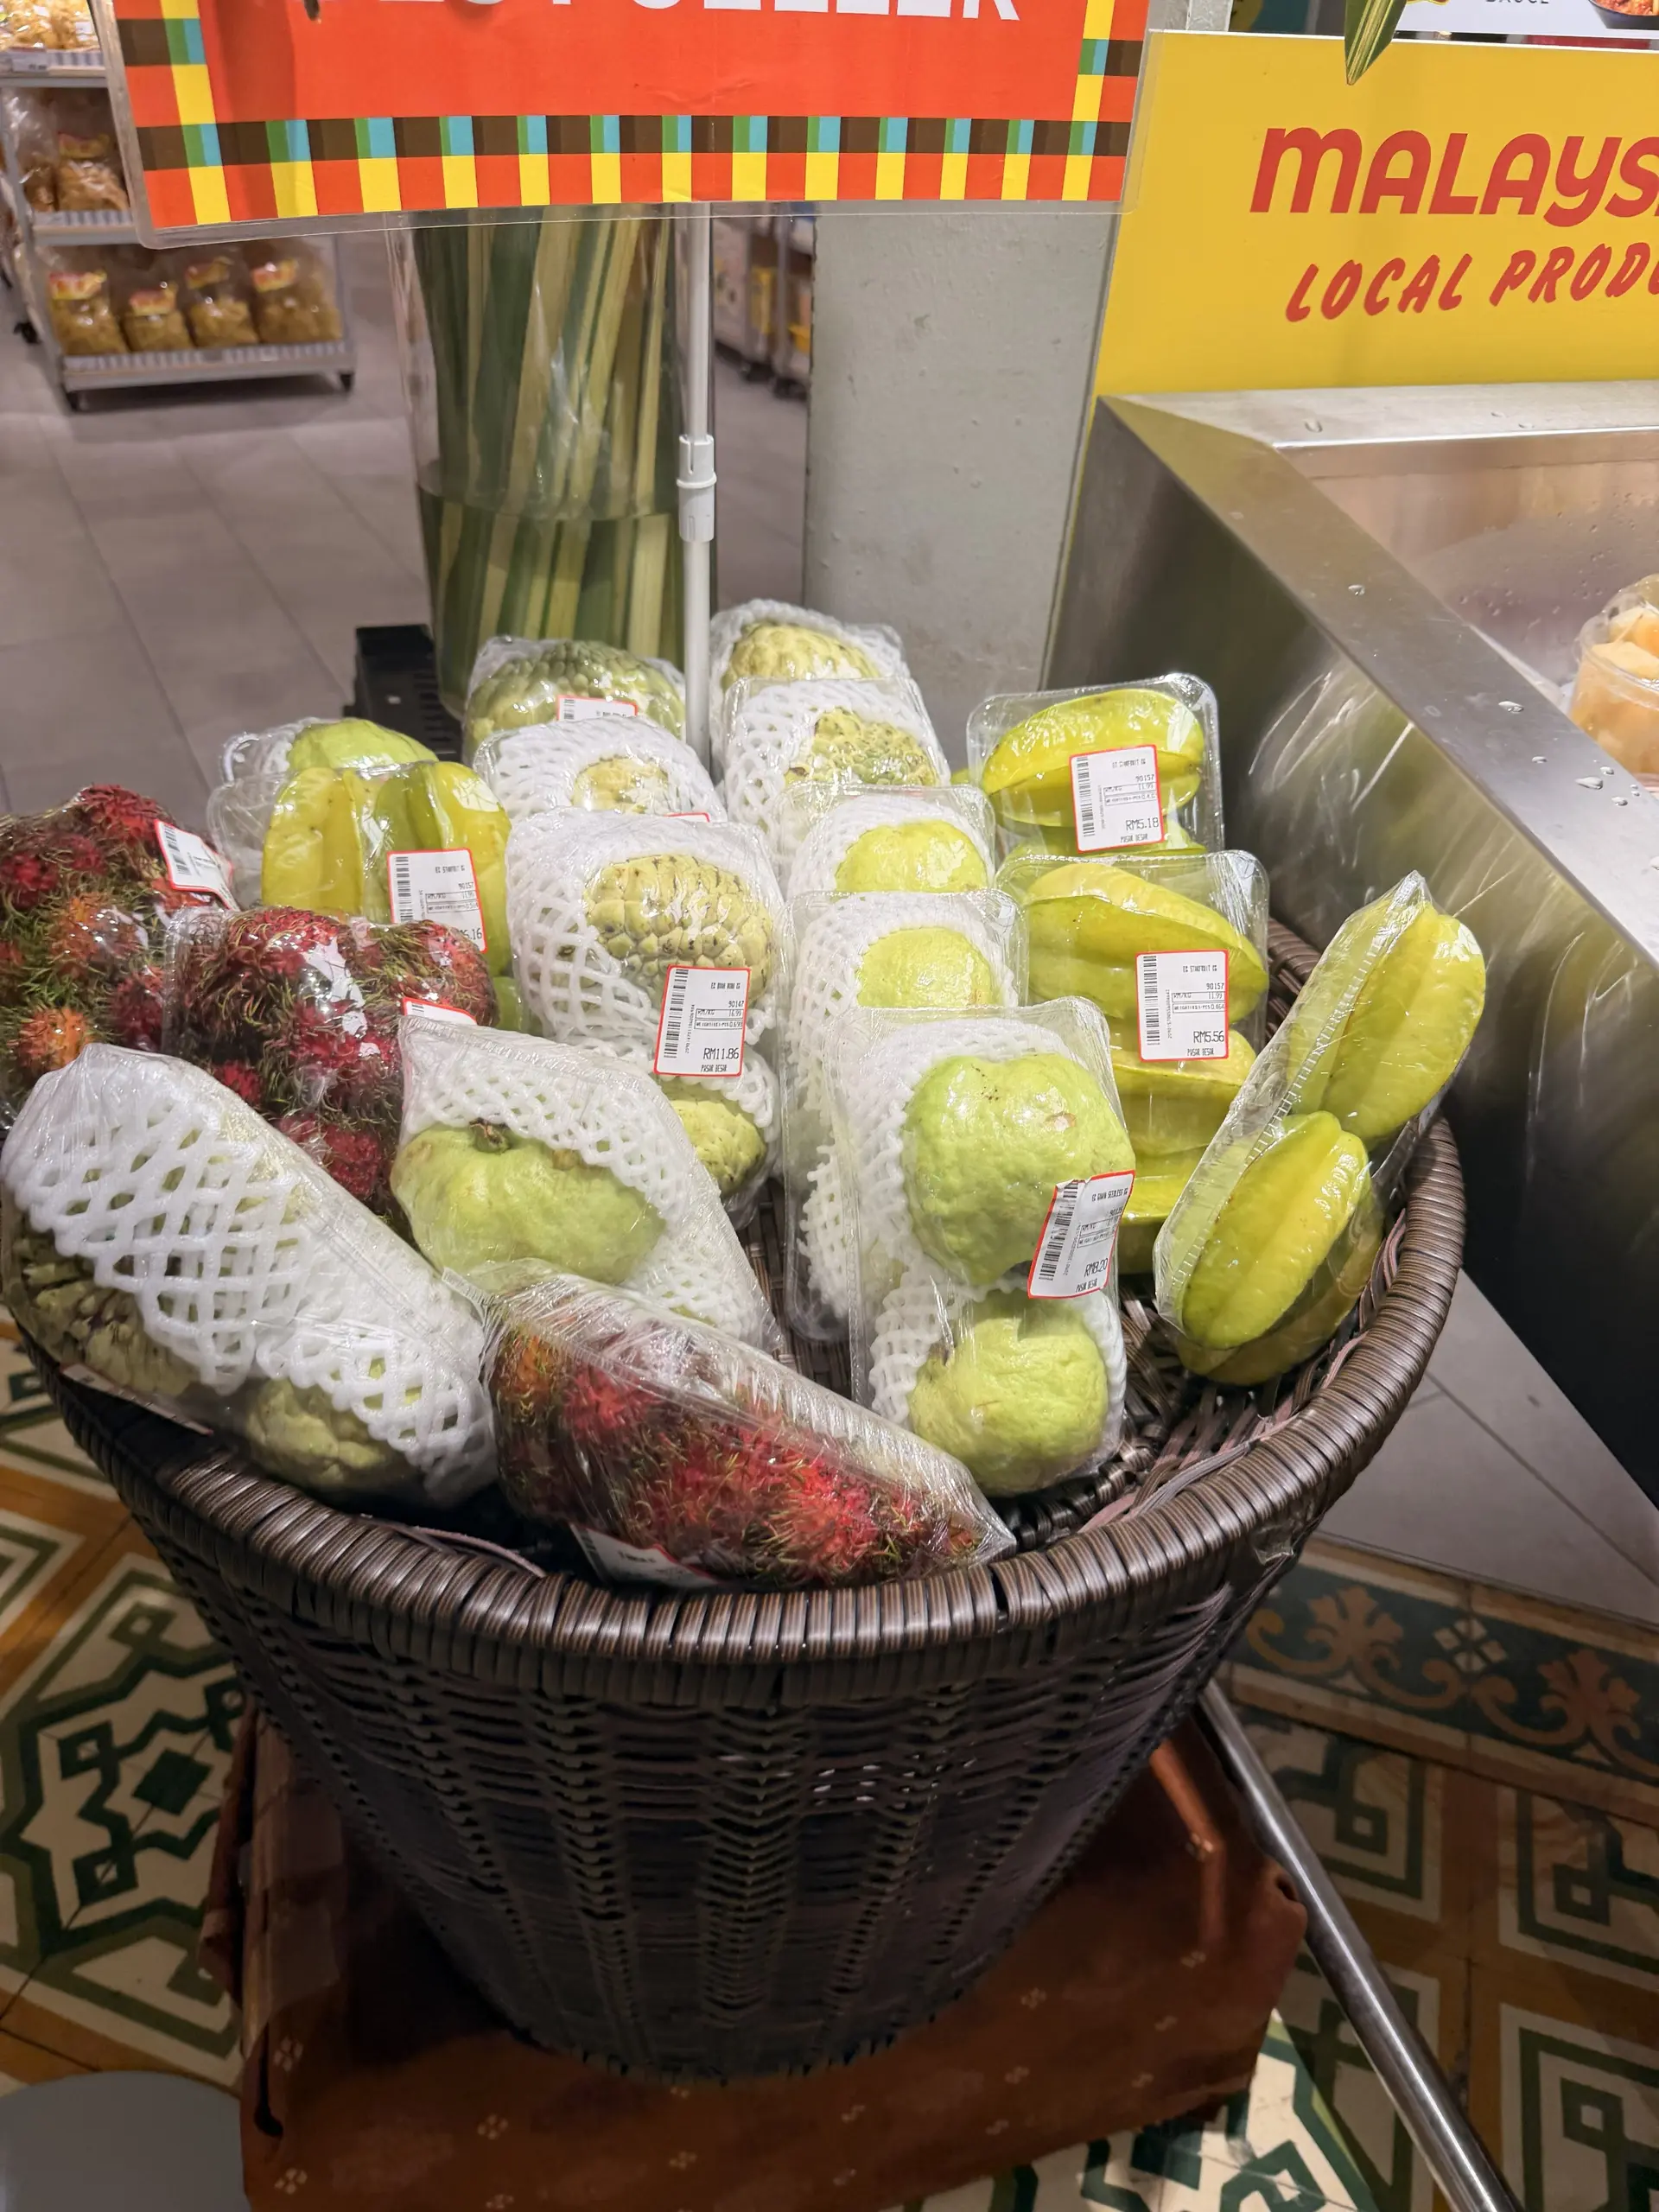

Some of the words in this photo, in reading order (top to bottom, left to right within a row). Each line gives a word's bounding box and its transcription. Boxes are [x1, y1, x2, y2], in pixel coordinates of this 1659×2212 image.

[1249, 127, 1659, 227] MALAYS
[1286, 253, 1472, 322] LOCAL
[1126, 817, 1159, 830] RM5.18
[1193, 1031, 1224, 1043] RM5.56
[703, 1047, 739, 1059] RM11.86
